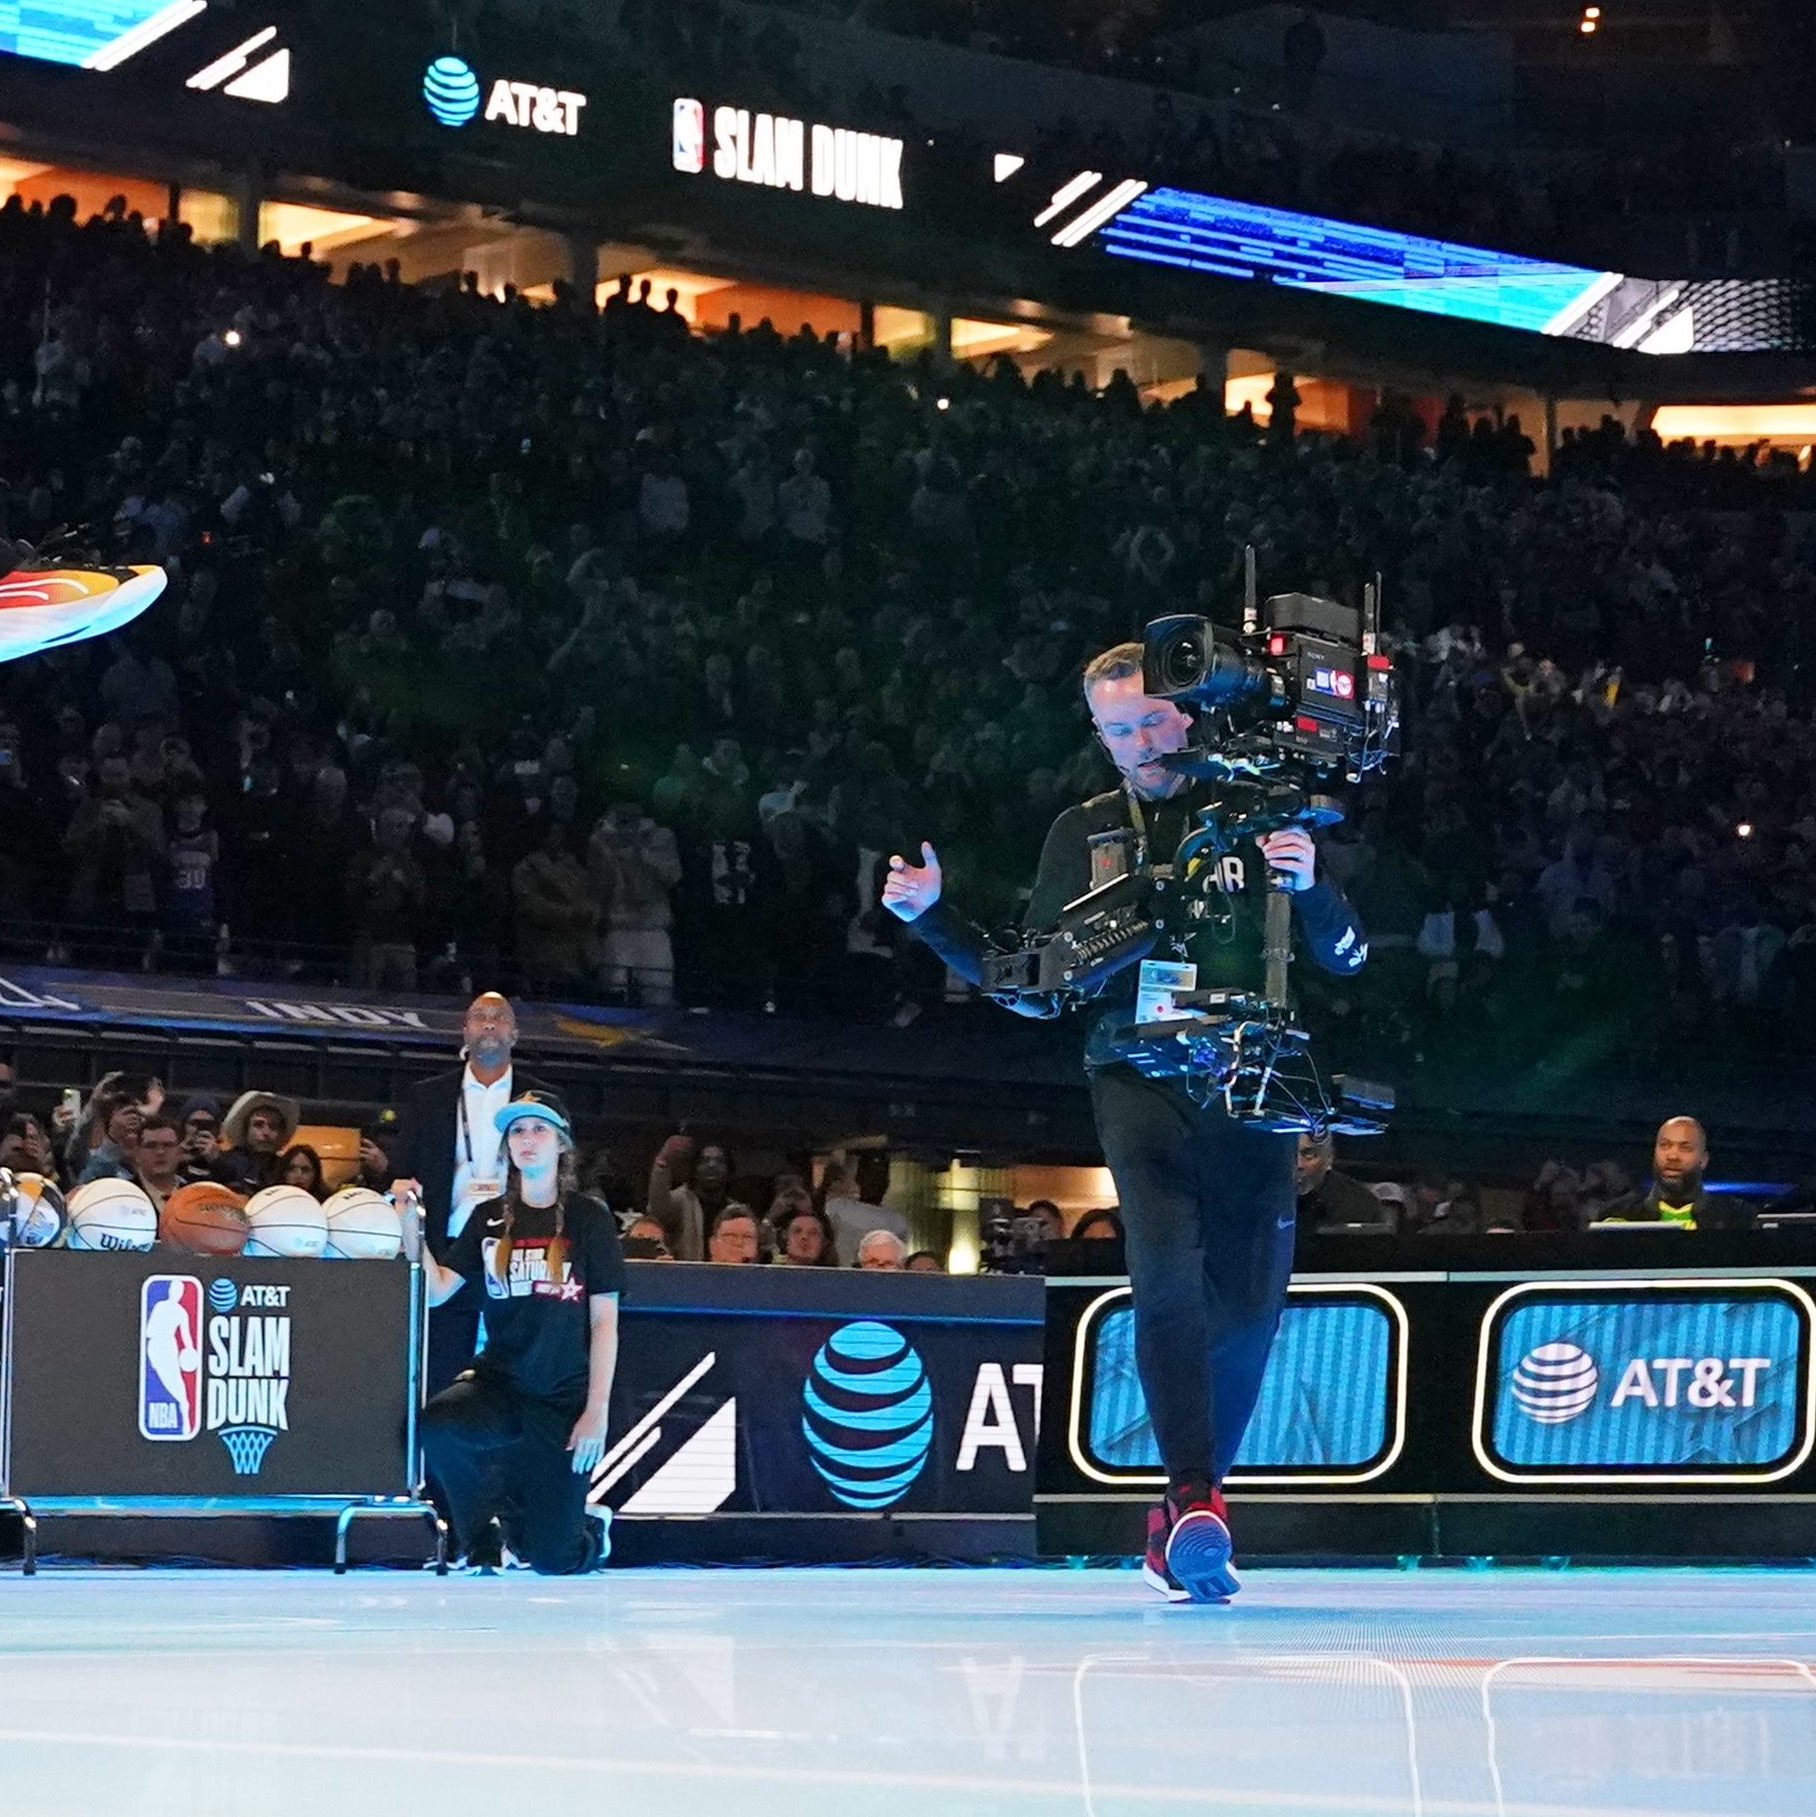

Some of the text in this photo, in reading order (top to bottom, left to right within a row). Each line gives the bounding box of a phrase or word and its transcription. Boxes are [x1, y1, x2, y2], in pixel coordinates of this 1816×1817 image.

[484, 79, 587, 136] AT&T
[713, 106, 904, 210] SLAM DUNK
[245, 1000, 429, 1029] INDY
[240, 1285, 291, 1307] AT&T
[509, 1259, 572, 1283] SATURY
[208, 1315, 291, 1377] SLAM
[206, 1378, 289, 1435] DUNK
[1611, 1357, 1771, 1407] AT&T
[148, 1402, 178, 1429] NBA
